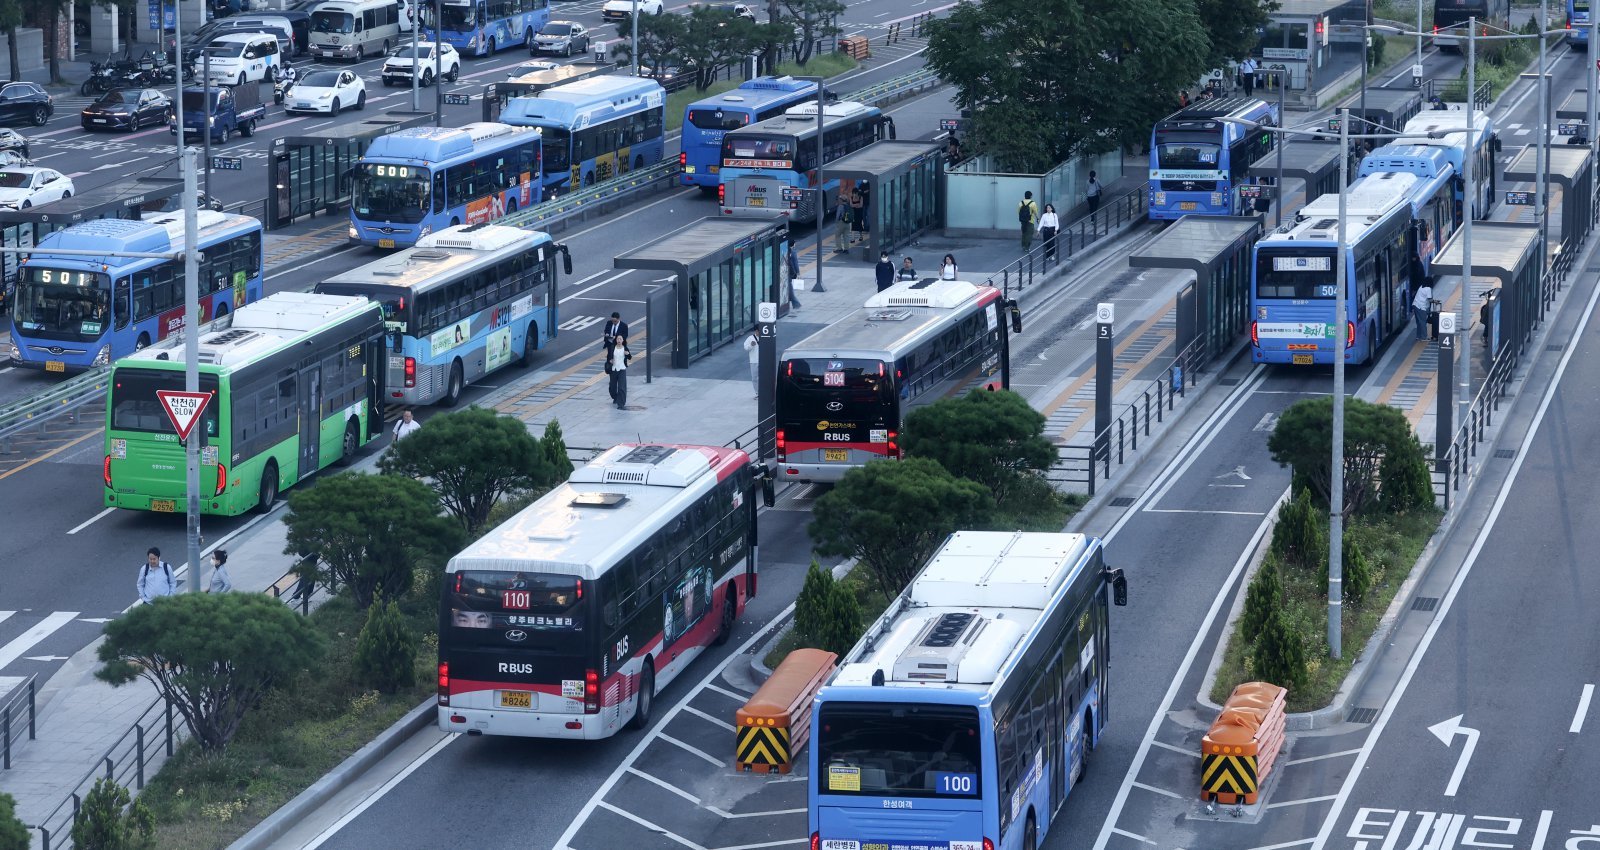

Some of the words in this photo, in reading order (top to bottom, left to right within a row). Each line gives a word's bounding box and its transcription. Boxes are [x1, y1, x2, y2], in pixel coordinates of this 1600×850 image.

[1201, 153, 1214, 161] 401
[377, 166, 408, 178] 500
[42, 270, 86, 286] 501
[218, 277, 228, 290] 501
[762, 325, 769, 335] 6
[1101, 326, 1108, 336] 5
[1442, 336, 1450, 346] 4
[824, 373, 845, 385] 5104
[170, 397, 197, 408] 천천히
[174, 408, 194, 416] SLOW
[504, 592, 530, 608] 1101
[616, 635, 629, 661] BUS
[509, 697, 530, 706] 8266
[943, 775, 971, 792] 100
[883, 800, 913, 809] 한성여객
[825, 840, 856, 850] 세란병원
